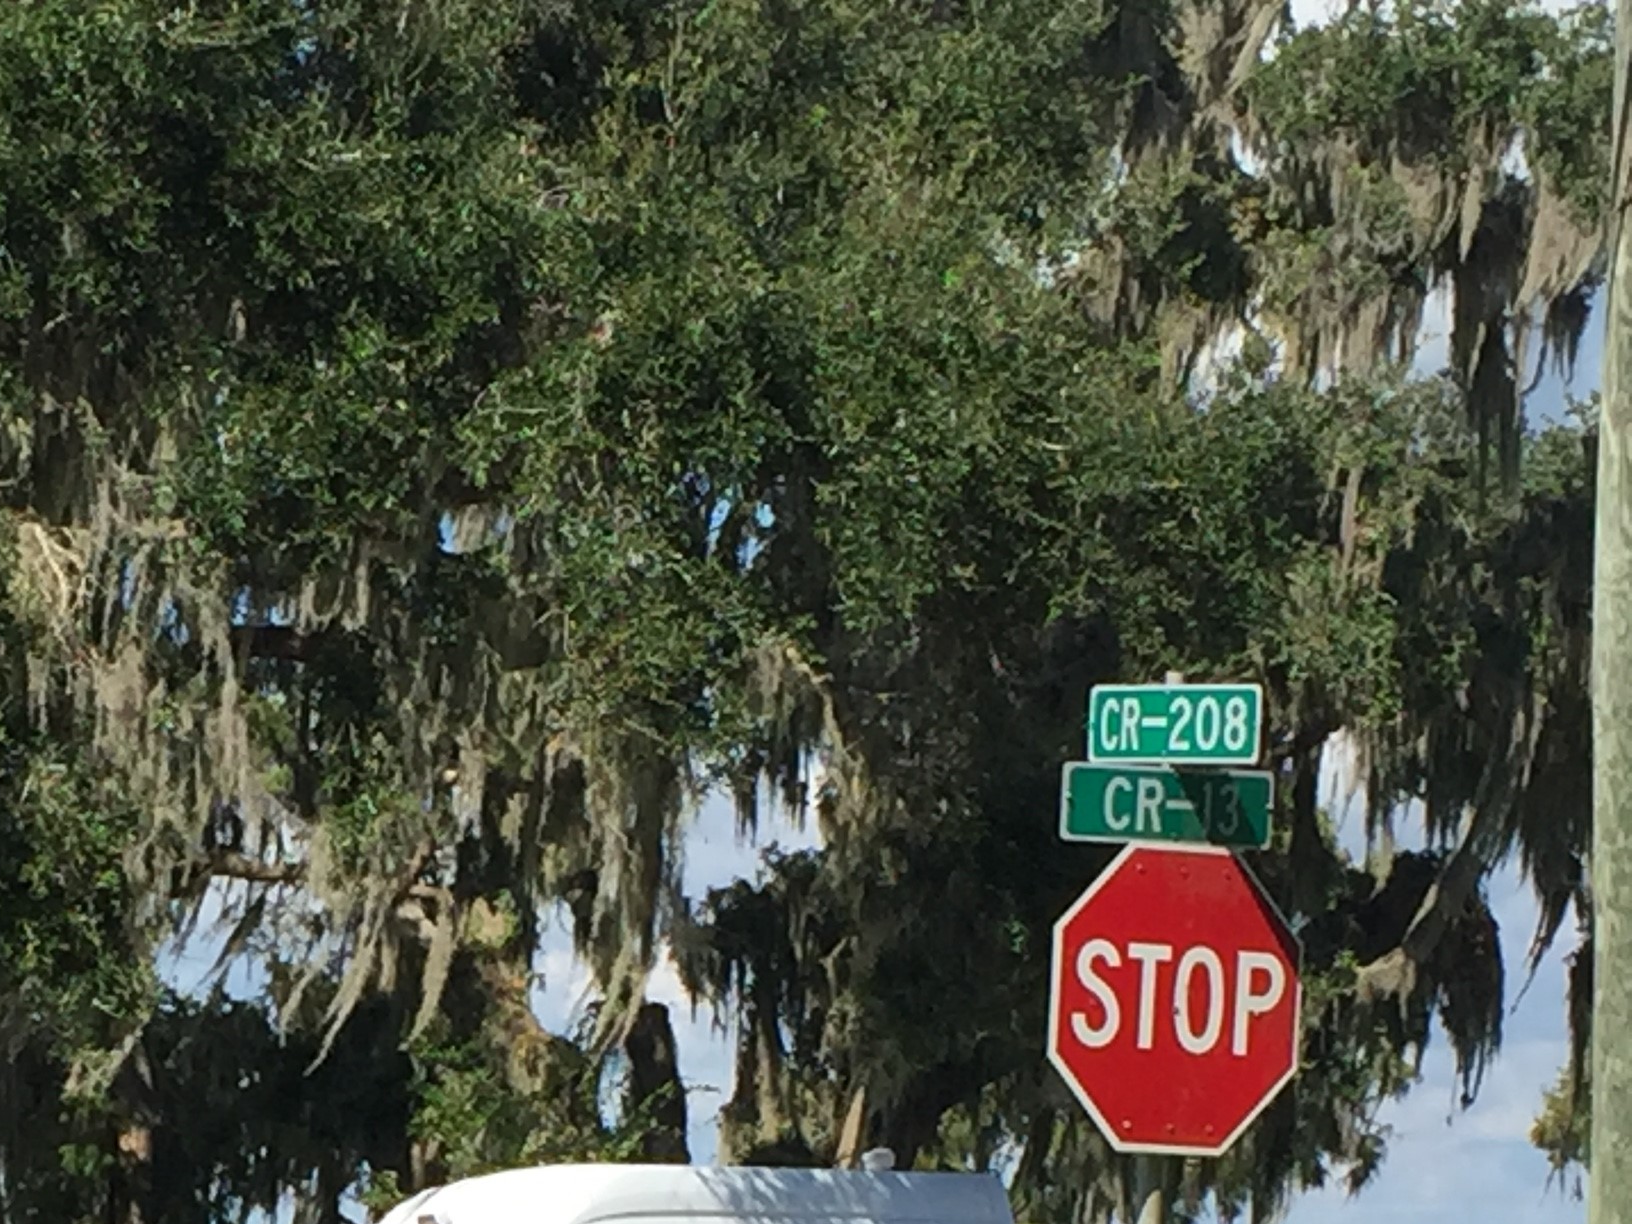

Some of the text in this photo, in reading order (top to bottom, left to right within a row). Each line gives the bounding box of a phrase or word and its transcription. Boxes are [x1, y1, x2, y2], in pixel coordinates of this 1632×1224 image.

[1100, 695, 1248, 751] CR-208
[1104, 775, 1239, 837] CR-13
[1071, 938, 1286, 1056] STOP
